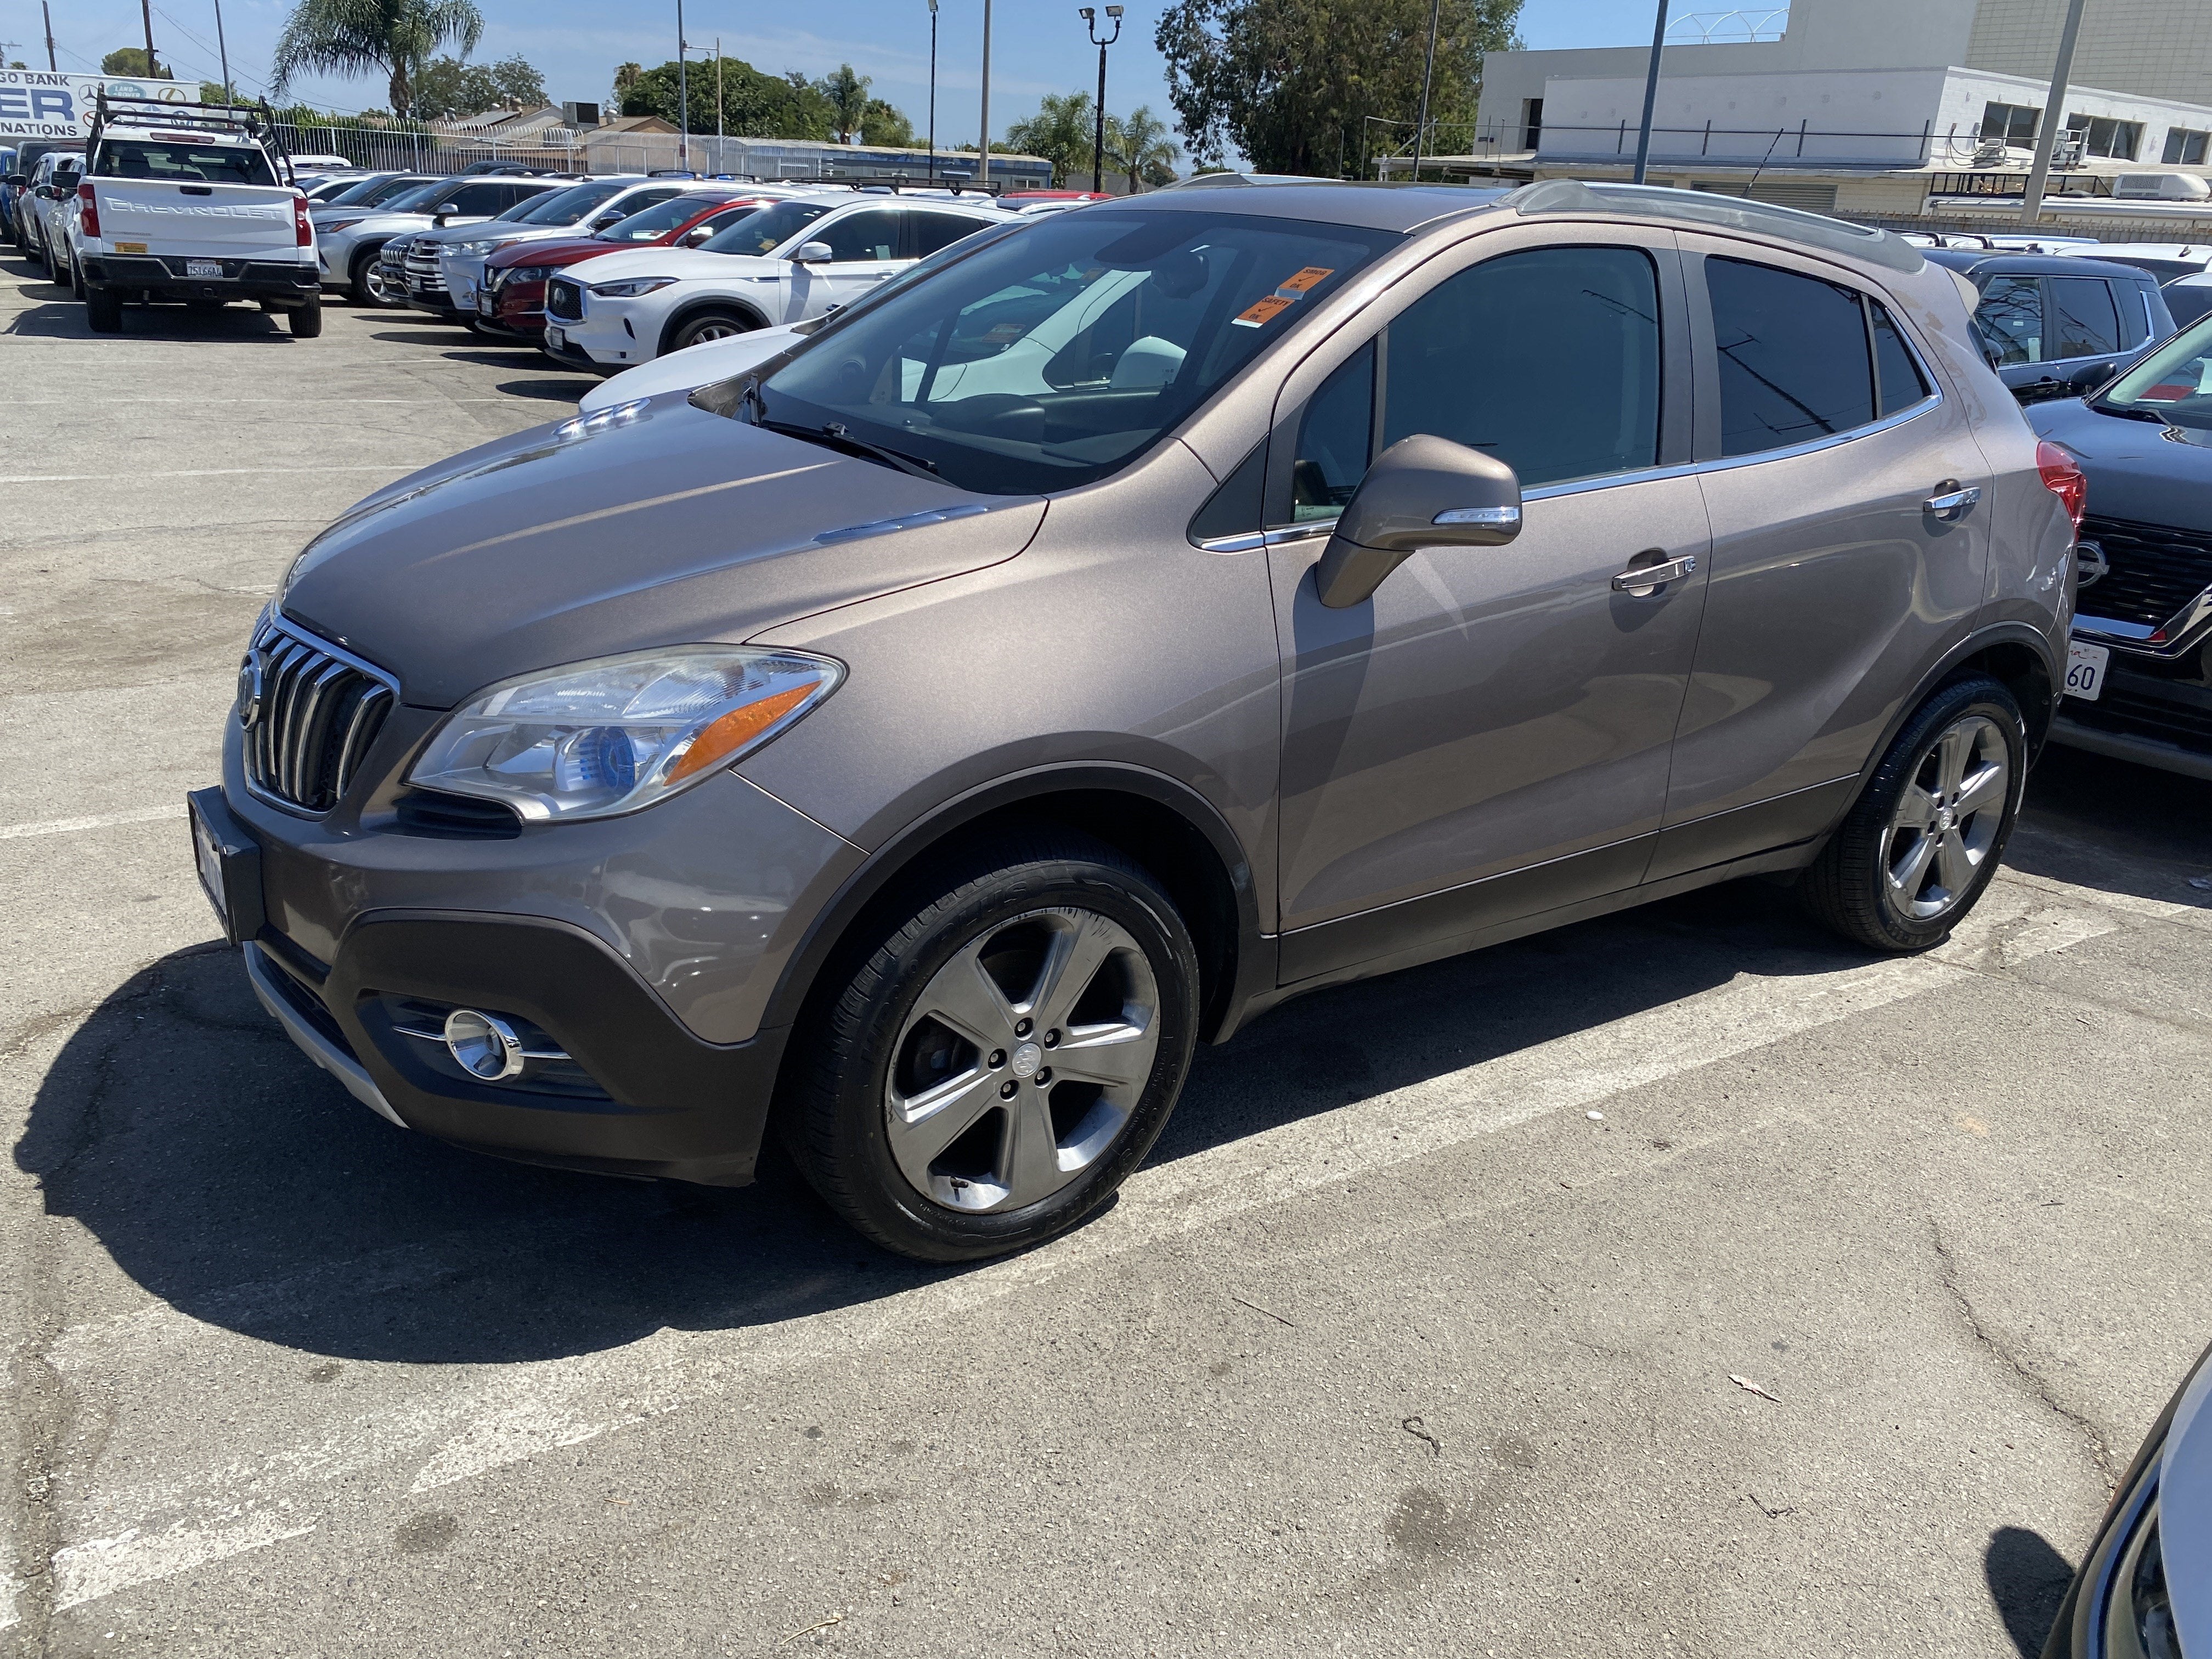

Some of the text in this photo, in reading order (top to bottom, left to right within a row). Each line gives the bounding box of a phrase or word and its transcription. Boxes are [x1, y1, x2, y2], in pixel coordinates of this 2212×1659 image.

[25, 73, 70, 86] BANK
[0, 87, 75, 121] ER
[0, 122, 77, 136] NATIONS
[110, 200, 283, 219] CHEVROLET
[1261, 297, 1290, 306] SAFETY
[2067, 664, 2096, 690] 60
